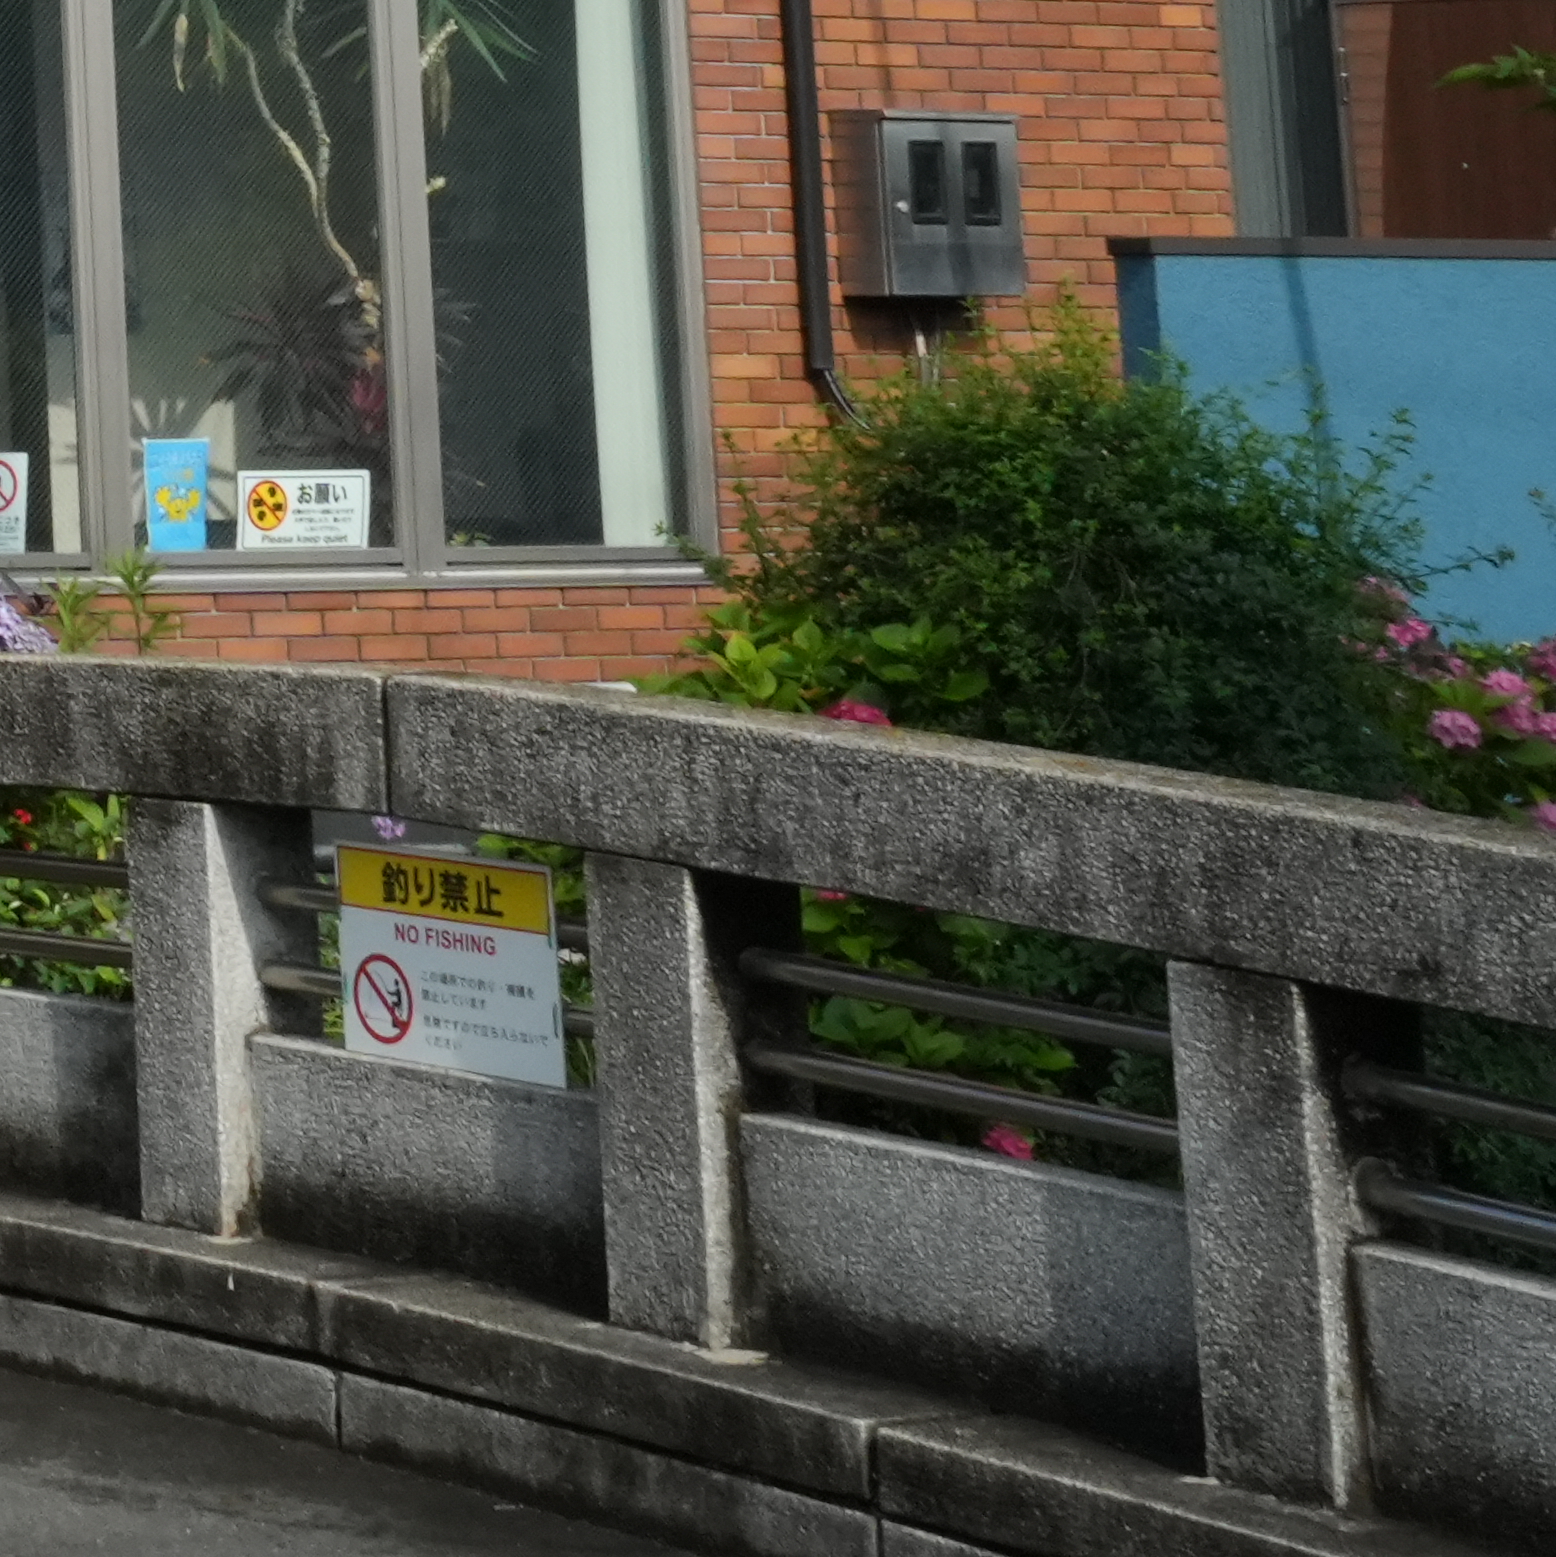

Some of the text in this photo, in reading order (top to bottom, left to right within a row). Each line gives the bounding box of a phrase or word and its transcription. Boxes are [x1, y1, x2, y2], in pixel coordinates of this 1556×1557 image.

[296, 482, 348, 505] お願い
[380, 861, 505, 919] 釣り禁止
[394, 923, 497, 957] NO FISHING
